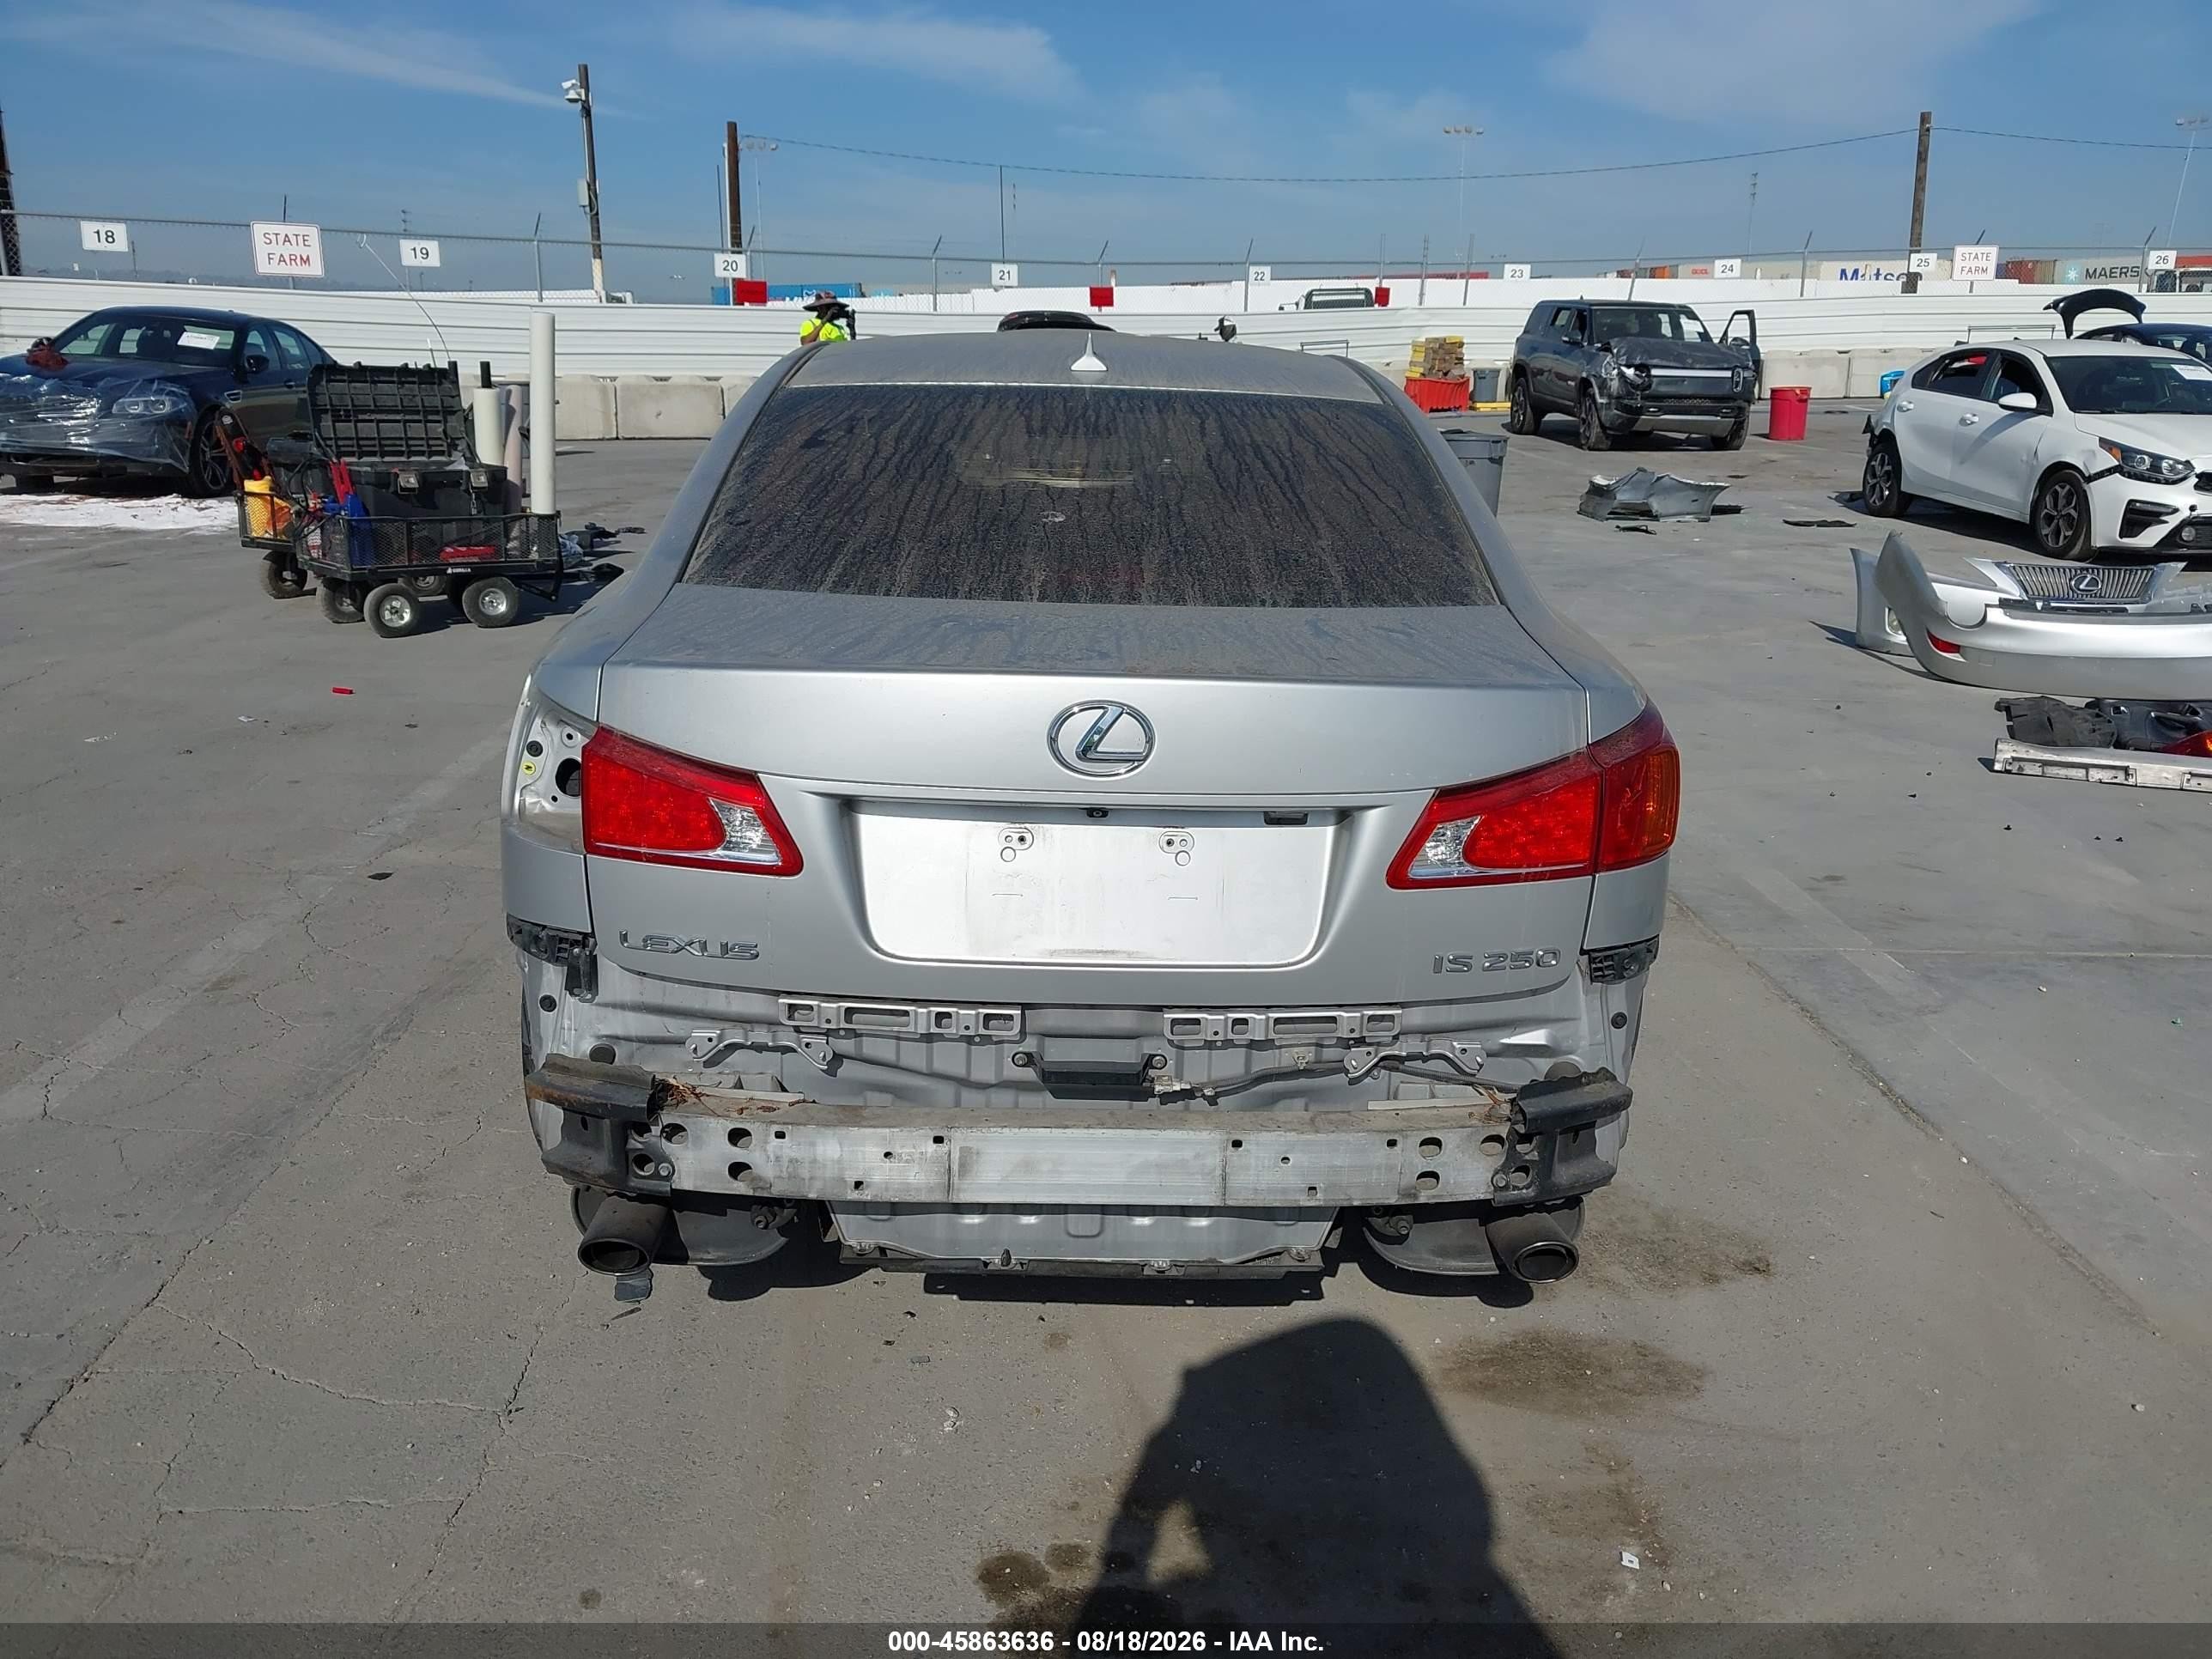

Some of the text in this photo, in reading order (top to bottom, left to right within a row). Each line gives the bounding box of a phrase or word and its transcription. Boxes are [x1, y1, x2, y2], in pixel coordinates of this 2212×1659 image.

[93, 228, 116, 245] 18
[263, 232, 312, 247] STATE
[410, 246, 430, 260] 19
[1960, 252, 1992, 262] STATE
[267, 252, 311, 268] FARM
[722, 259, 738, 272] 20
[1916, 258, 1930, 268] 25
[2154, 255, 2169, 265] 26
[1510, 268, 1524, 279] 23
[1720, 264, 1735, 274] 24
[1960, 265, 1989, 276] FARM
[999, 270, 1011, 281] 21
[1254, 270, 1266, 282] 22
[619, 929, 760, 960] LEXUS
[1432, 949, 1561, 974] IS 250
